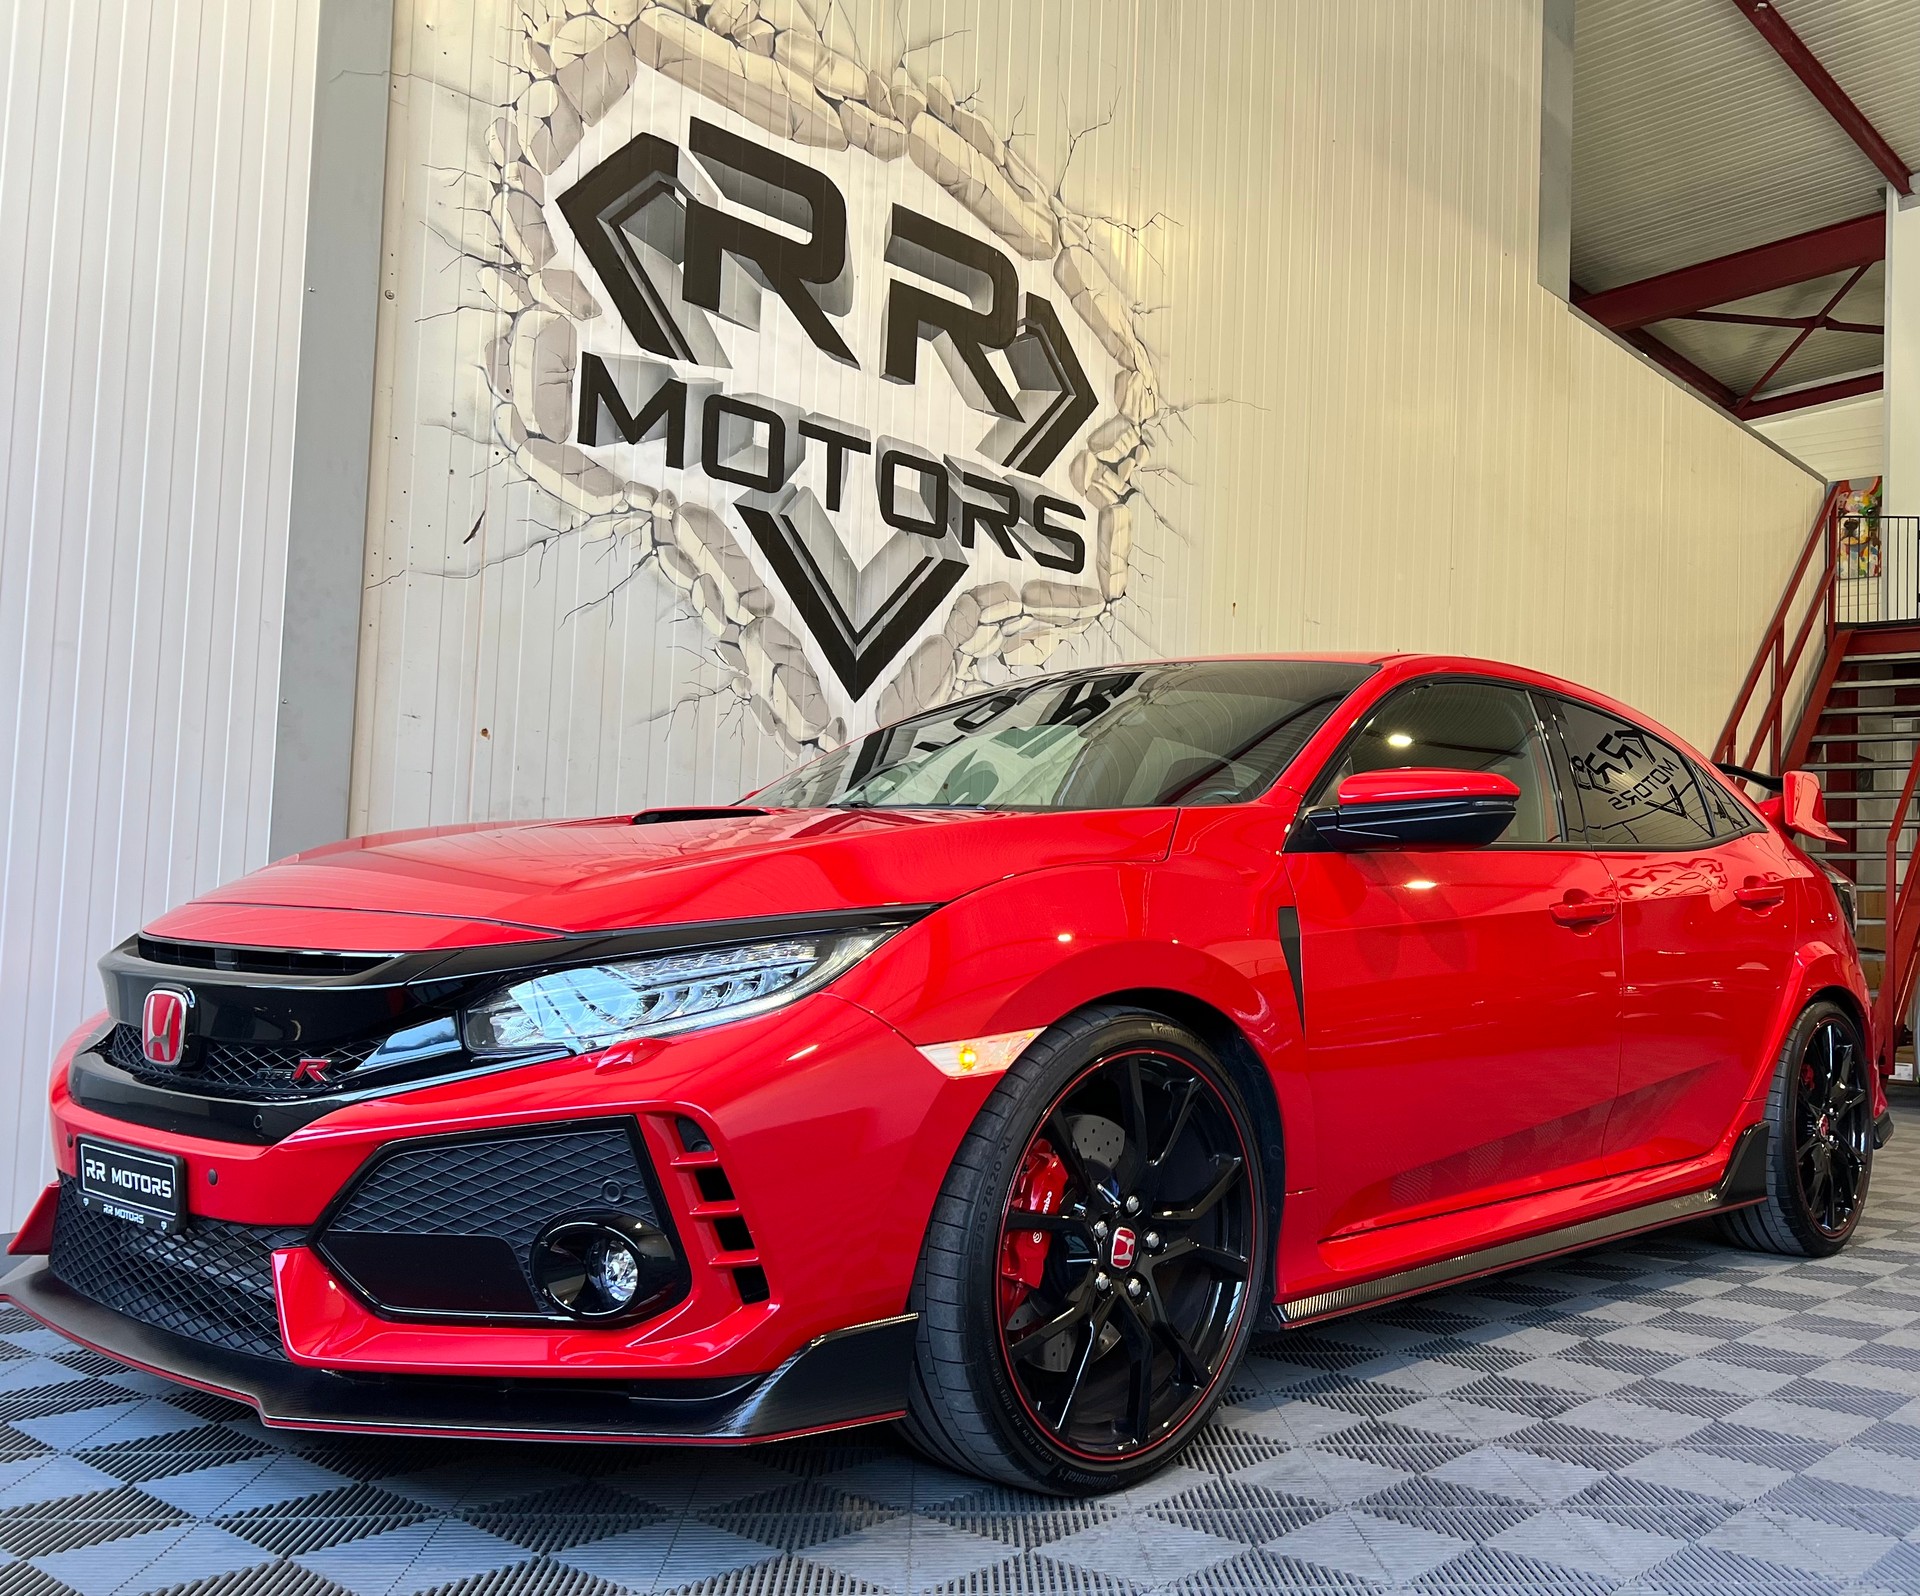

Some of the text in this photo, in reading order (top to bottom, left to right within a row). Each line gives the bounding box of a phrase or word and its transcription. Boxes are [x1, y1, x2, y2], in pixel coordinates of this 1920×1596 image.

[682, 116, 1026, 423] RR
[577, 351, 1087, 575] MOTORS
[85, 1158, 172, 1199] RR MOTORS
[103, 1204, 145, 1225] RR MOTORS
